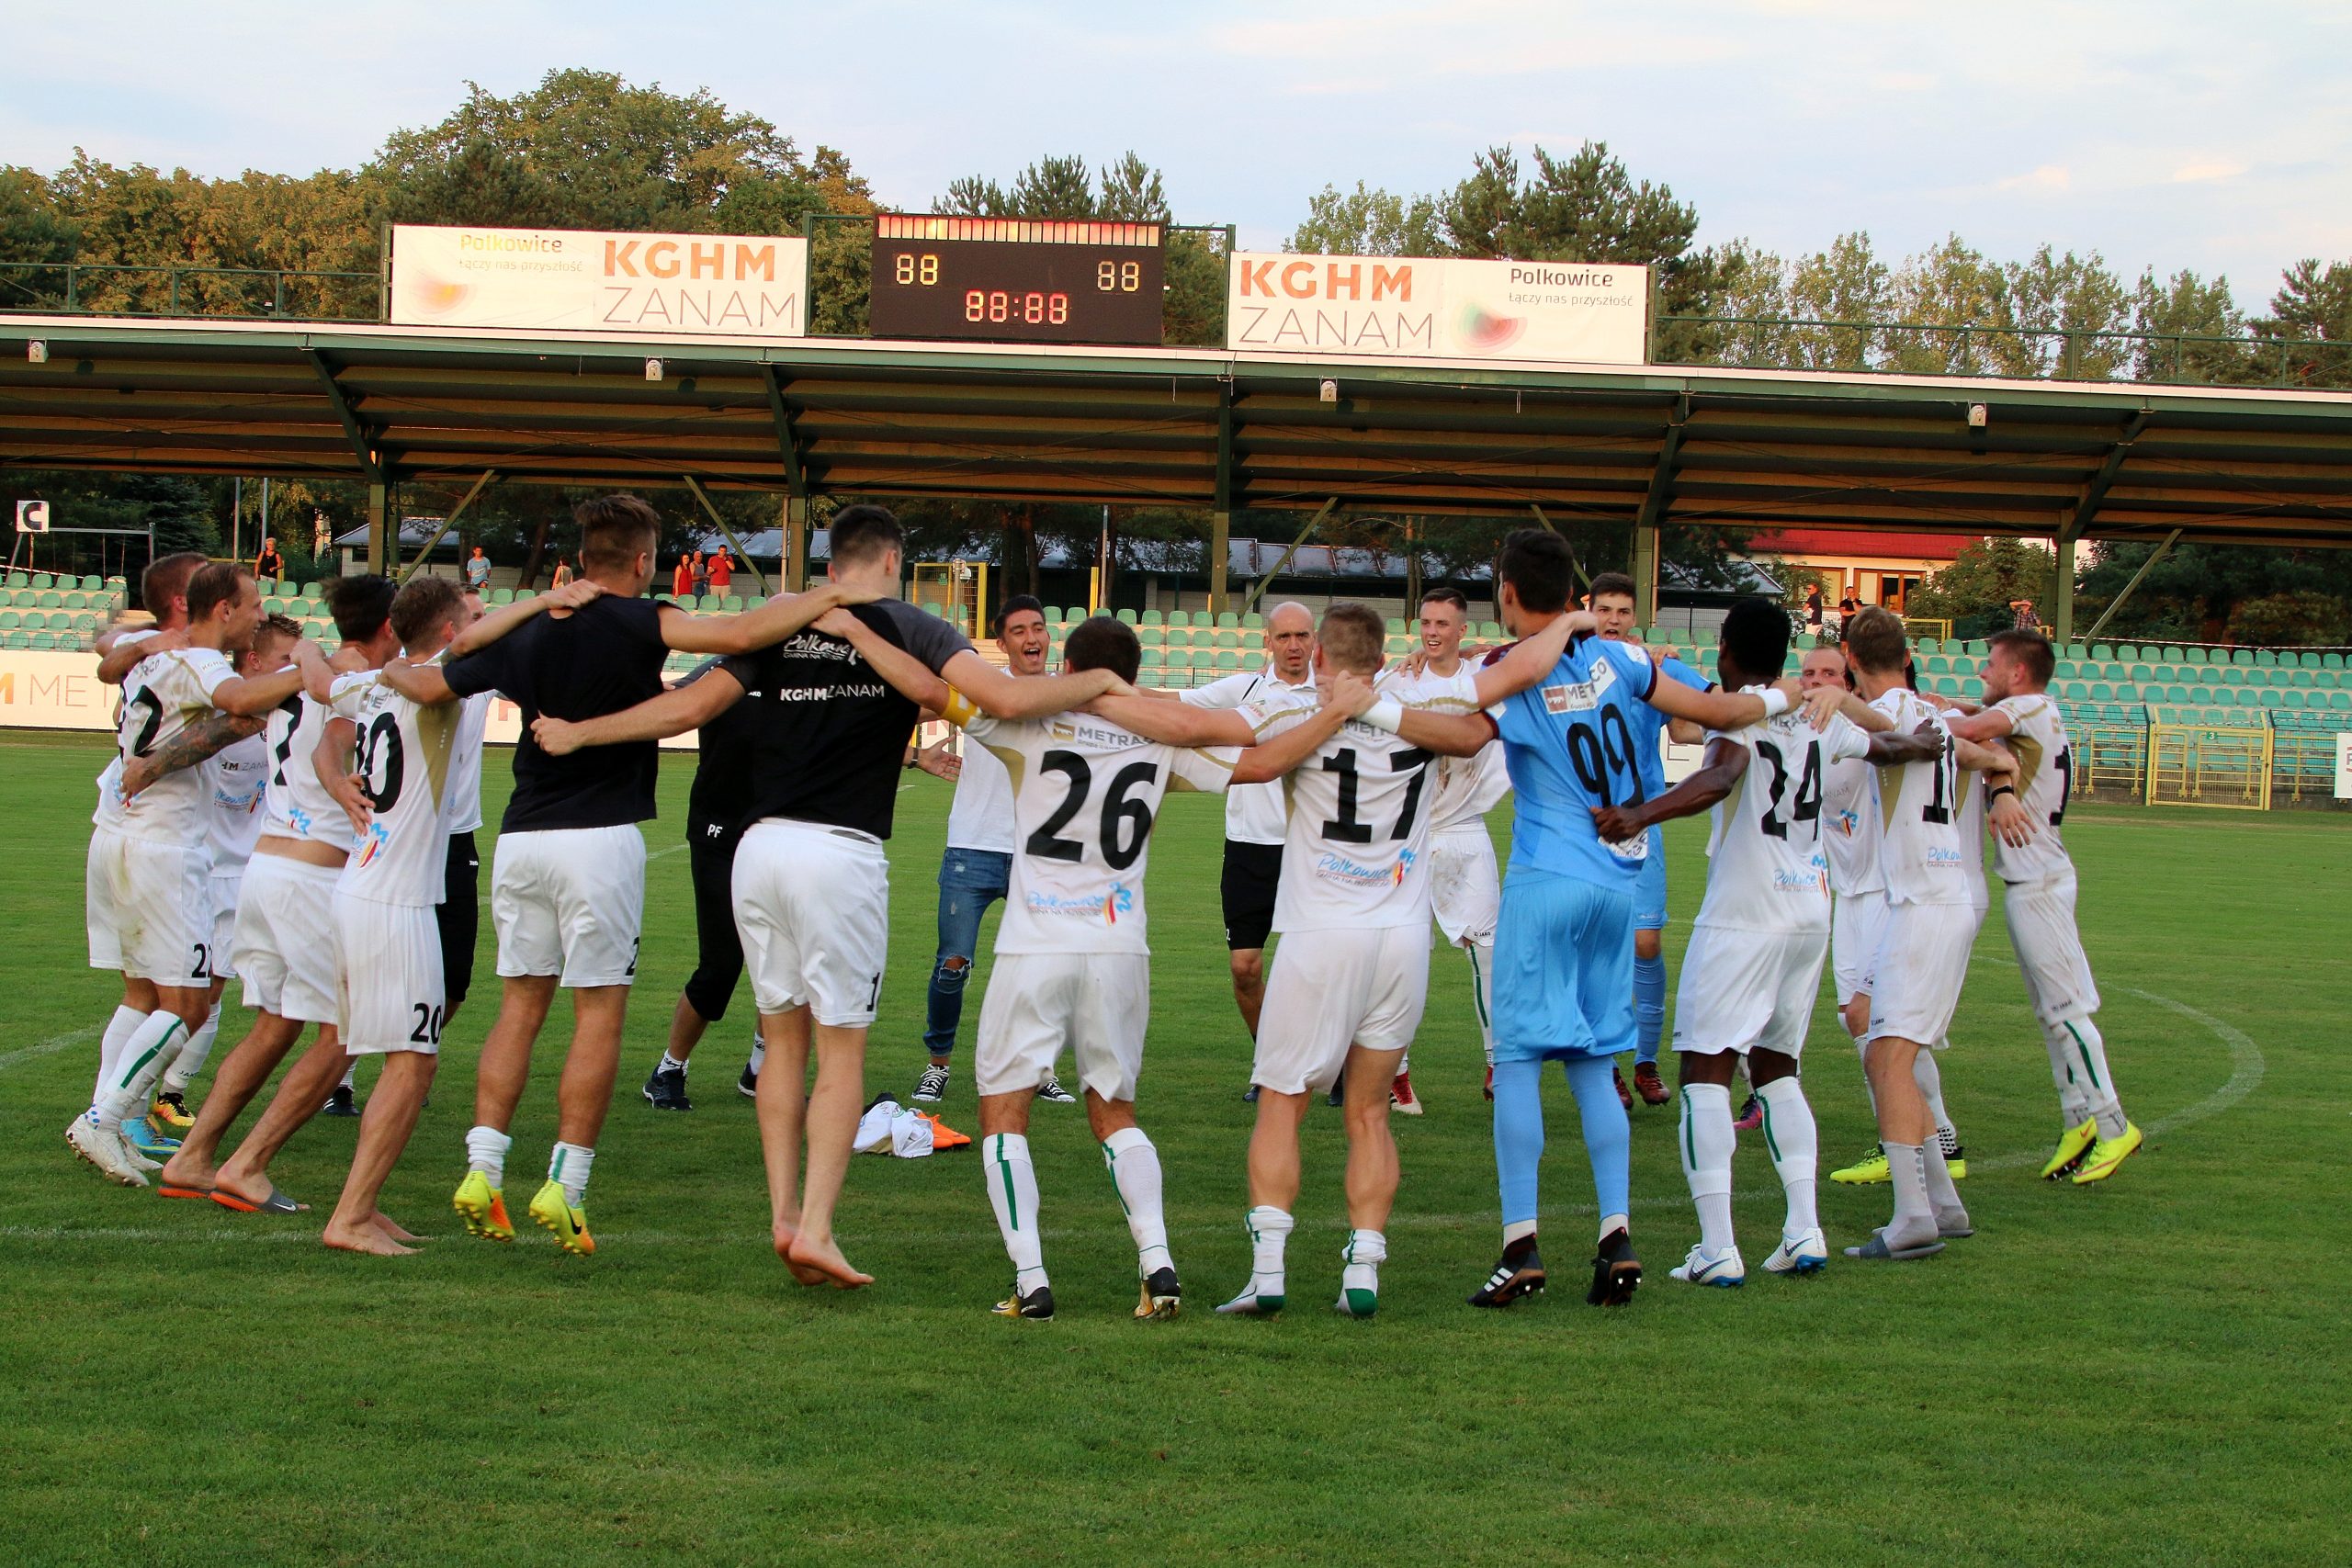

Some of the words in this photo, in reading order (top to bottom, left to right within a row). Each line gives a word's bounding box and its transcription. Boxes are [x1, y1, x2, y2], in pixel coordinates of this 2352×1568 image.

[460, 234, 562, 253] Polkowice
[495, 261, 516, 270] nas
[521, 261, 583, 273] przyszłość
[604, 240, 775, 282] KGHM
[896, 254, 938, 286] 88
[1098, 261, 1139, 292] 88
[1240, 260, 1412, 302] KGHM
[1510, 268, 1613, 288] Polkowice
[603, 287, 796, 329] ZANAM
[966, 289, 1068, 324] 88:88
[1509, 292, 1542, 305] Łączy
[1545, 295, 1567, 304] nas
[1571, 295, 1633, 307] przyszłość
[1239, 307, 1432, 350] ZANAM
[23, 502, 42, 530] C
[780, 687, 828, 702] KGHM
[1566, 702, 1645, 811] 99
[1322, 747, 1436, 843] 17
[1755, 739, 1823, 842] 24
[1025, 749, 1159, 871] 26
[707, 823, 723, 838] PF
[1317, 852, 1391, 879] Polkowice
[411, 1002, 443, 1043] 20
